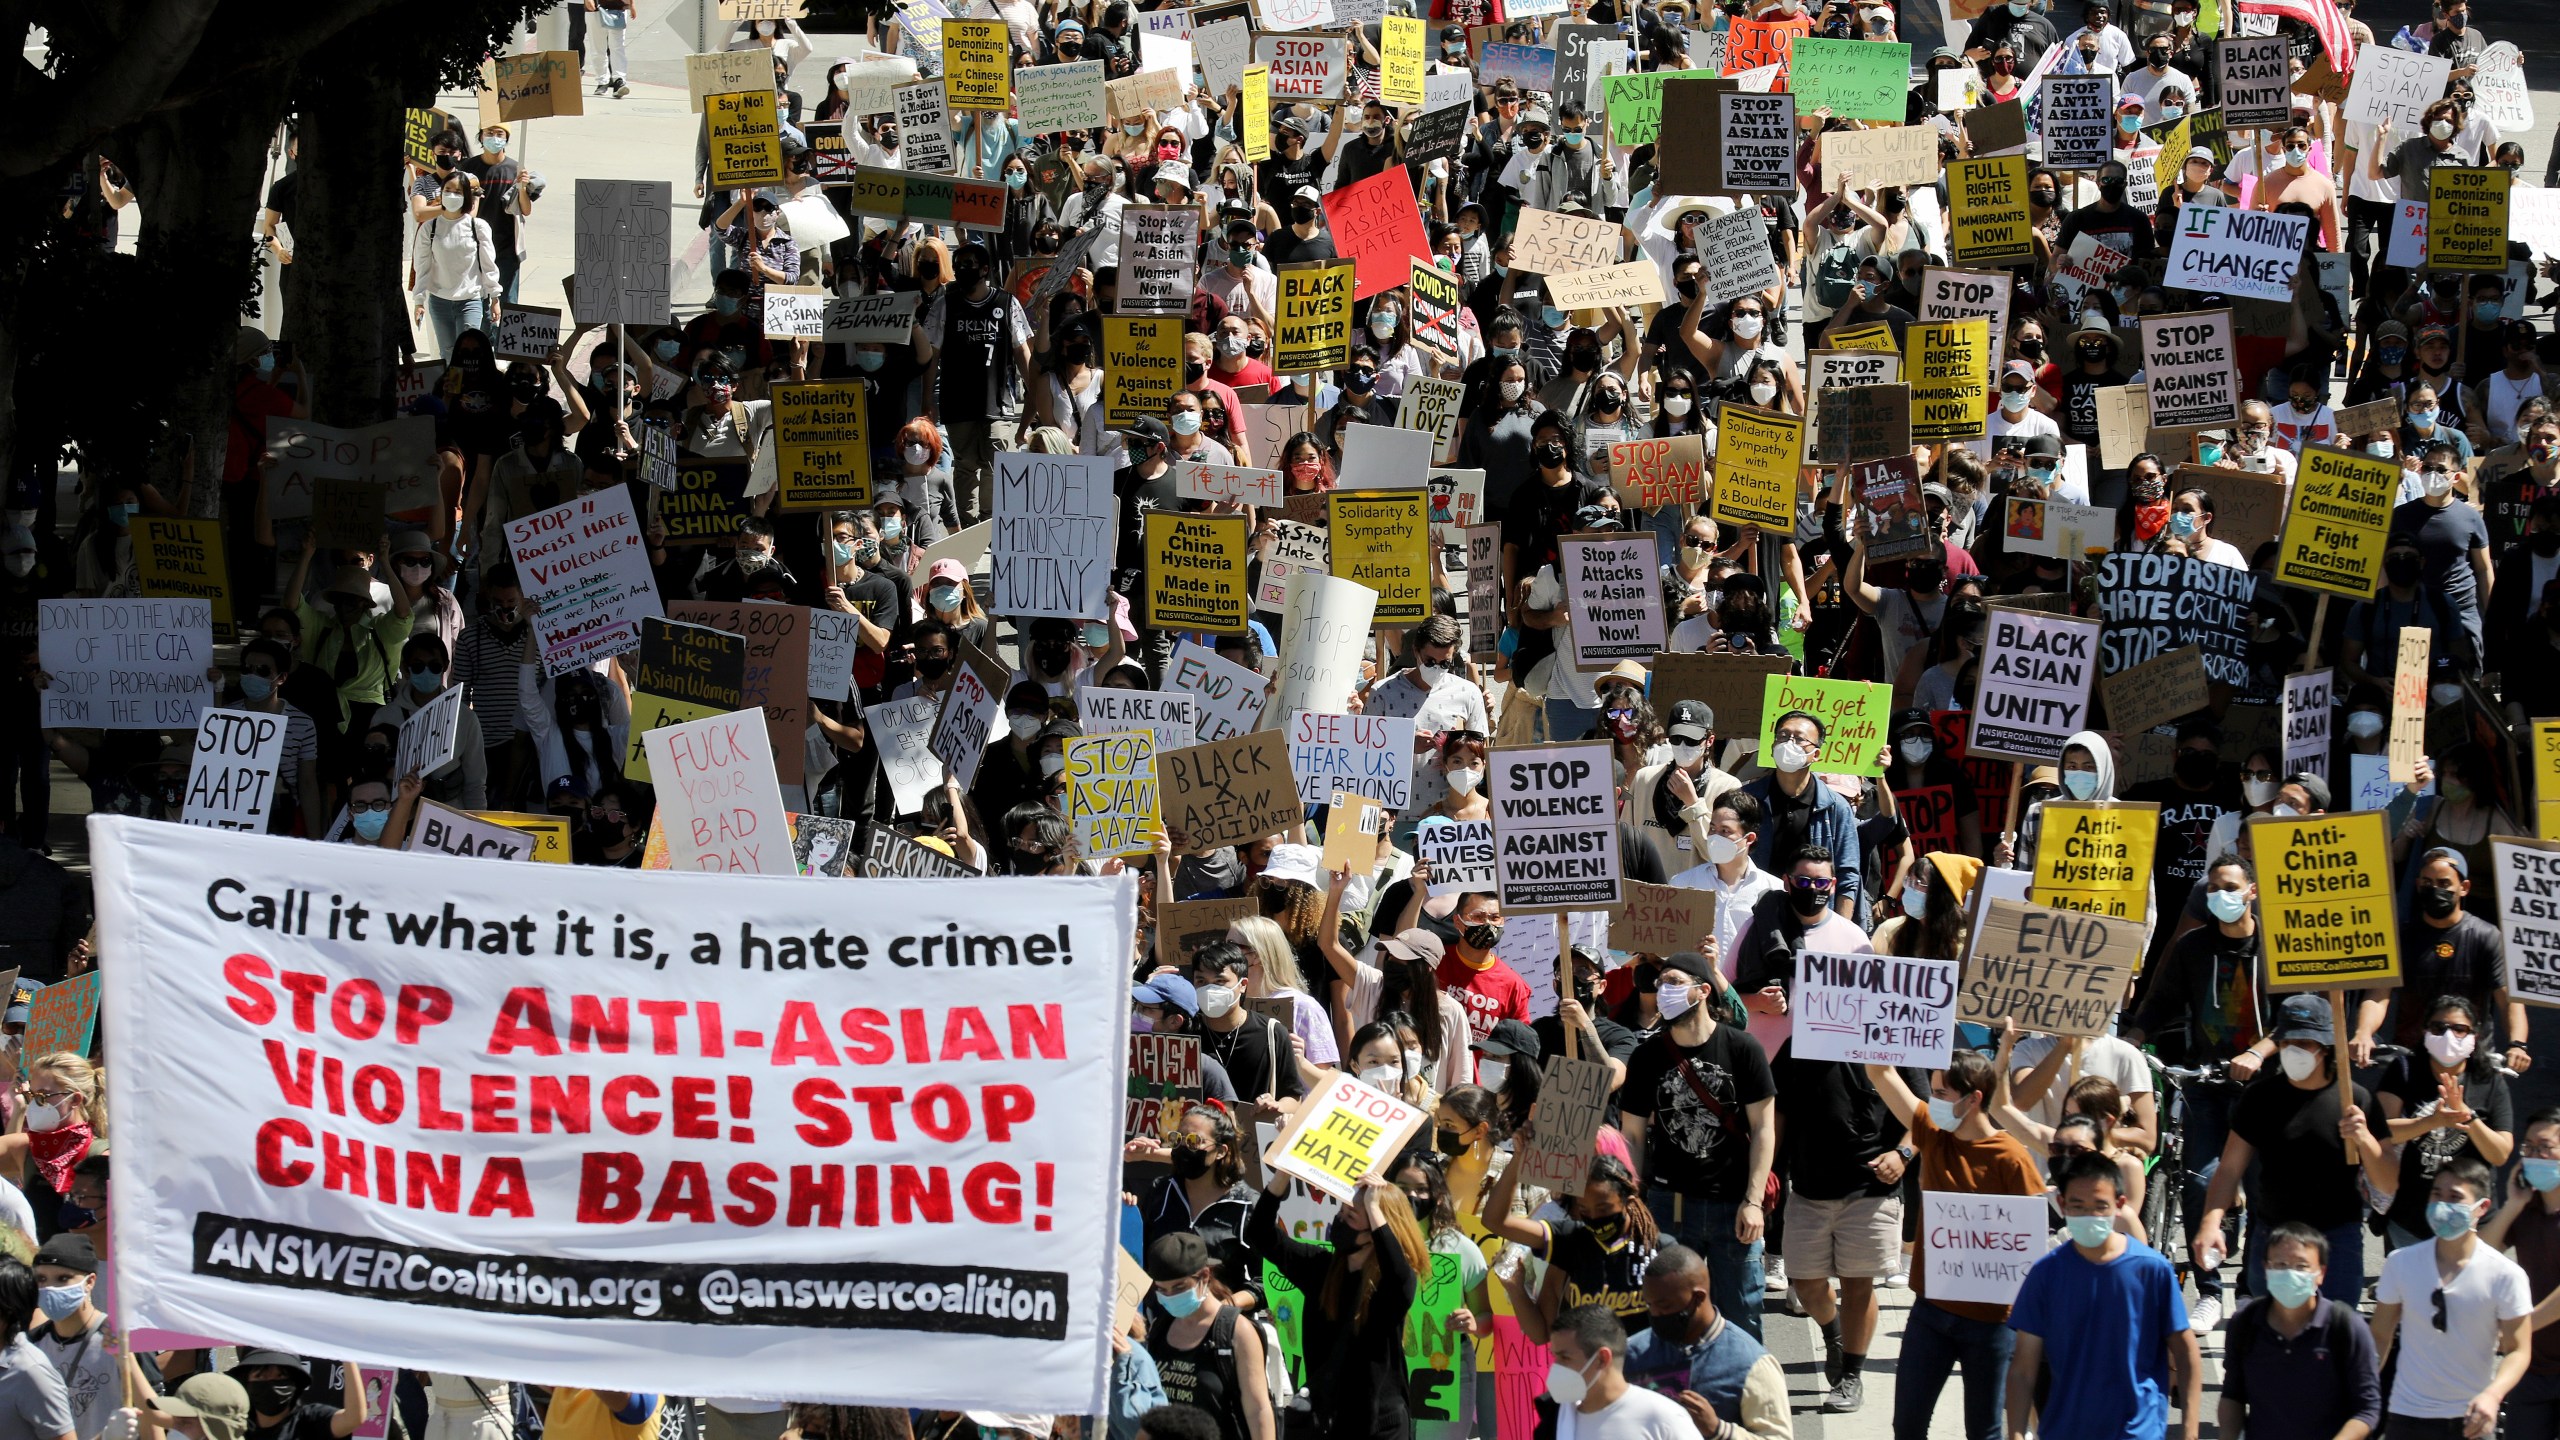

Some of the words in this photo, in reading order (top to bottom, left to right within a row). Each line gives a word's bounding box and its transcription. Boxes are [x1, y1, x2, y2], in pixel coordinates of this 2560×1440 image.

[962, 27, 990, 37] STOP
[948, 38, 1004, 52] Demonizing
[1275, 41, 1324, 57] STOP
[2225, 45, 2281, 64] BLACK
[959, 52, 994, 63] China
[2378, 53, 2434, 78] STOP
[948, 70, 964, 78] and
[966, 69, 1004, 81] Chinese
[1271, 60, 1328, 76] ASIAN
[2226, 65, 2282, 80] ASIAN
[956, 80, 998, 94] People!
[1275, 78, 1323, 94] HATE
[2052, 82, 2100, 95] STOP
[2227, 87, 2285, 105] UNITY
[2362, 74, 2429, 100] ASIAN
[719, 98, 742, 113] Say
[744, 96, 764, 111] No!
[2052, 96, 2100, 107] ANTI-
[737, 112, 748, 123] to
[2048, 109, 2105, 120] ASIAN
[2227, 108, 2286, 119] ANSWERCOALITION.ORG
[2368, 102, 2419, 125] HATE
[714, 122, 774, 138] Anti-Asian
[2048, 125, 2106, 138] ATTACKS
[725, 142, 766, 155] Racist
[2054, 138, 2100, 150] NOW
[724, 155, 769, 169] Terror!
[1965, 163, 2009, 180] FULL
[579, 182, 656, 207] WE
[858, 182, 900, 197] STOP
[906, 184, 953, 199] ASIAN
[955, 192, 1000, 209] HATE
[1341, 179, 1393, 215] STOP
[1966, 180, 2011, 195] RIGHTS
[1967, 196, 1989, 206] FOR
[1992, 194, 2011, 205] ALL
[579, 207, 670, 235] STAND
[1139, 215, 1167, 230] Stop
[1170, 218, 1183, 229] the
[1344, 199, 1406, 241] ASIAN
[1958, 212, 2025, 226] IMMIGRANTS
[1134, 230, 1184, 245] Attacks
[1347, 225, 1402, 260] HATE
[1973, 227, 2012, 243] NOW!
[575, 234, 670, 263] UNITED
[1132, 249, 1145, 258] on
[1147, 248, 1183, 260] Asian
[1959, 244, 2028, 257] AnswerCoalition.org
[575, 263, 671, 289] AGAINST
[1133, 266, 1180, 279] Women
[1139, 282, 1172, 296] Now!
[1285, 273, 1345, 297] BLACK
[575, 290, 671, 325] HATE
[1286, 296, 1342, 318] LIVES
[1281, 321, 1344, 345] MATTER
[2156, 325, 2214, 347] STOP
[1279, 347, 1344, 361] ANSWERCOALITION.ORG
[2151, 348, 2224, 367] VIOLENCE
[1410, 381, 1461, 401] ASIANS
[2153, 372, 2226, 392] AGAINST
[782, 390, 855, 406] Solidarity
[1419, 396, 1445, 413] FOR
[2154, 391, 2227, 409] WOMEN!
[782, 412, 806, 424] with
[811, 410, 856, 424] Asian
[2154, 406, 2230, 418] ANSWERCOALITION.ORG
[782, 427, 859, 442] Communities
[1403, 413, 1455, 436] LOVE
[803, 451, 842, 467] Fight
[1612, 442, 1670, 467] STOP
[793, 470, 855, 488] Racism!
[1627, 462, 1700, 490] ASIAN
[788, 490, 861, 500] ANSWERCoalition.org
[1001, 462, 1106, 519] MODEL
[1642, 482, 1700, 508] HATE
[1338, 505, 1405, 519] Solidarity
[1408, 505, 1419, 516] &
[999, 516, 1105, 557] MINORITY
[1174, 521, 1217, 537] Anti-
[1345, 523, 1413, 538] Sympathy
[1168, 536, 1224, 554] China
[1367, 541, 1392, 552] with
[1161, 552, 1231, 570] Hysteria
[1352, 564, 1411, 578] Atlanta
[992, 557, 1094, 613] MUTINY
[1164, 575, 1210, 592] Made
[1216, 580, 1230, 594] in
[1156, 591, 1239, 613] Washington
[41, 603, 94, 630] DON'T
[103, 606, 128, 630] DO
[132, 605, 164, 629] THE
[171, 606, 212, 629] WORK
[1157, 611, 1238, 625] ANSWERCoalition.org
[76, 637, 100, 663] OF
[113, 634, 150, 660] THE
[156, 634, 192, 661] CIA
[1996, 624, 2088, 659] BLACK
[1990, 654, 2081, 687] ASIAN
[56, 671, 100, 693] STOP
[110, 670, 205, 694] PROPAGANDA
[48, 698, 88, 721] FROM
[112, 699, 147, 722] THE
[156, 700, 196, 722] USA
[1985, 691, 2081, 728] UNITY
[198, 713, 276, 759] STOP
[668, 723, 750, 777] FUCK
[1510, 761, 1590, 792] STOP
[187, 765, 270, 815] AAPI
[680, 770, 752, 813] YOUR
[1501, 797, 1604, 818] VIOLENCE
[692, 809, 756, 847] BAD
[2075, 815, 2122, 834] Anti-
[1504, 832, 1607, 856] AGAINST
[2292, 826, 2346, 847] Anti-
[2065, 837, 2127, 859] China
[697, 844, 760, 874] DAY
[2284, 848, 2358, 871] China
[1506, 858, 1606, 881] WOMEN!
[2053, 860, 2134, 886] Hysteria
[1507, 882, 1609, 892] ANSWERCOALITION.ORG
[2277, 870, 2370, 896] Hysteria
[1535, 891, 1612, 902] @answercoalition
[1637, 886, 1677, 903] STOP
[1623, 903, 1690, 924] ASIAN
[2284, 907, 2343, 928] Made
[2351, 906, 2370, 924] in
[206, 878, 310, 936] Call
[328, 895, 366, 942] it
[386, 902, 536, 956] what
[556, 910, 594, 958] it
[614, 914, 670, 970] is,
[690, 932, 720, 966] a
[741, 922, 869, 971] hate
[888, 924, 1074, 968] crime!
[1632, 926, 1677, 944] HATE
[2018, 912, 2108, 959] END
[2275, 930, 2385, 958] Washington
[1983, 953, 2114, 995] WHITE
[2281, 956, 2385, 973] ANSWERCoalition.org
[224, 952, 454, 1045] STOP
[487, 987, 1067, 1067] ANTI-ASIAN
[1963, 980, 2119, 1030] SUPREMACY
[262, 1039, 754, 1144] VIOLENCE!
[792, 1077, 1037, 1148] STOP
[1335, 1082, 1407, 1125] STOP
[1325, 1110, 1381, 1149] THE
[1295, 1135, 1367, 1182] HATE
[256, 1117, 535, 1219] CHINA
[576, 1151, 1055, 1232] BASHING!
[207, 1226, 662, 1317] ANSWERCoalition.org
[699, 1269, 1057, 1323] @answercoalition
